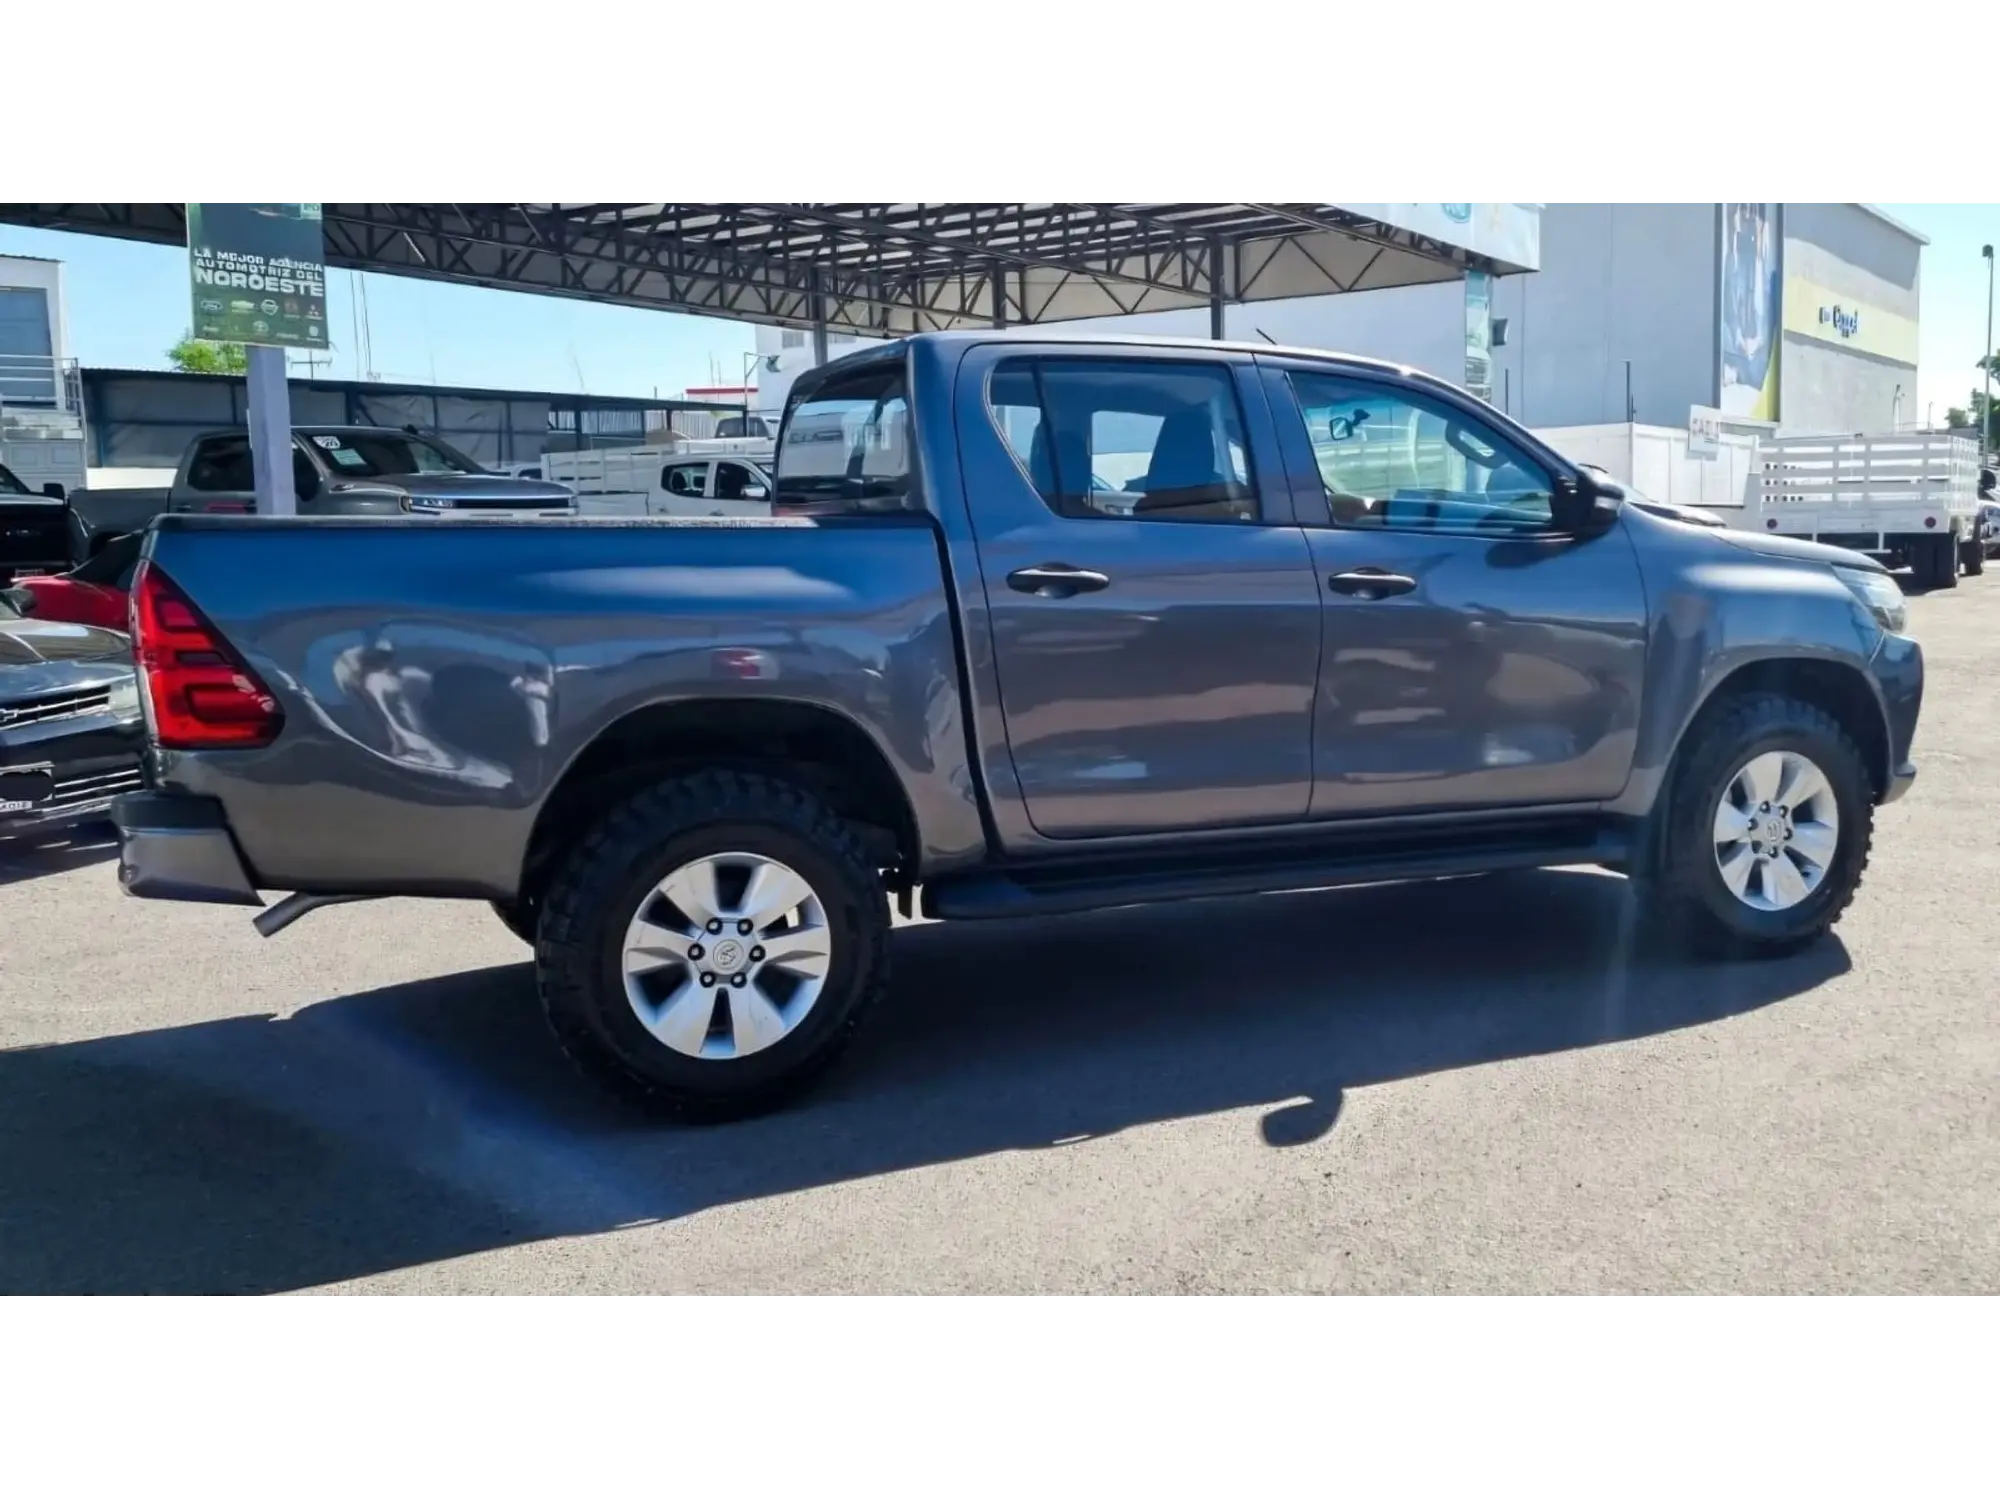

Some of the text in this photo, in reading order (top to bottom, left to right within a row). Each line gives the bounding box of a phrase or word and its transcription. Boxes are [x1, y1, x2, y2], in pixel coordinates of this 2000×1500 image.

[194, 247, 323, 272] LA MEJOR AGENCIA
[196, 258, 322, 281] AUTOMOTRIZ DEL
[194, 267, 324, 297] NOROESTE
